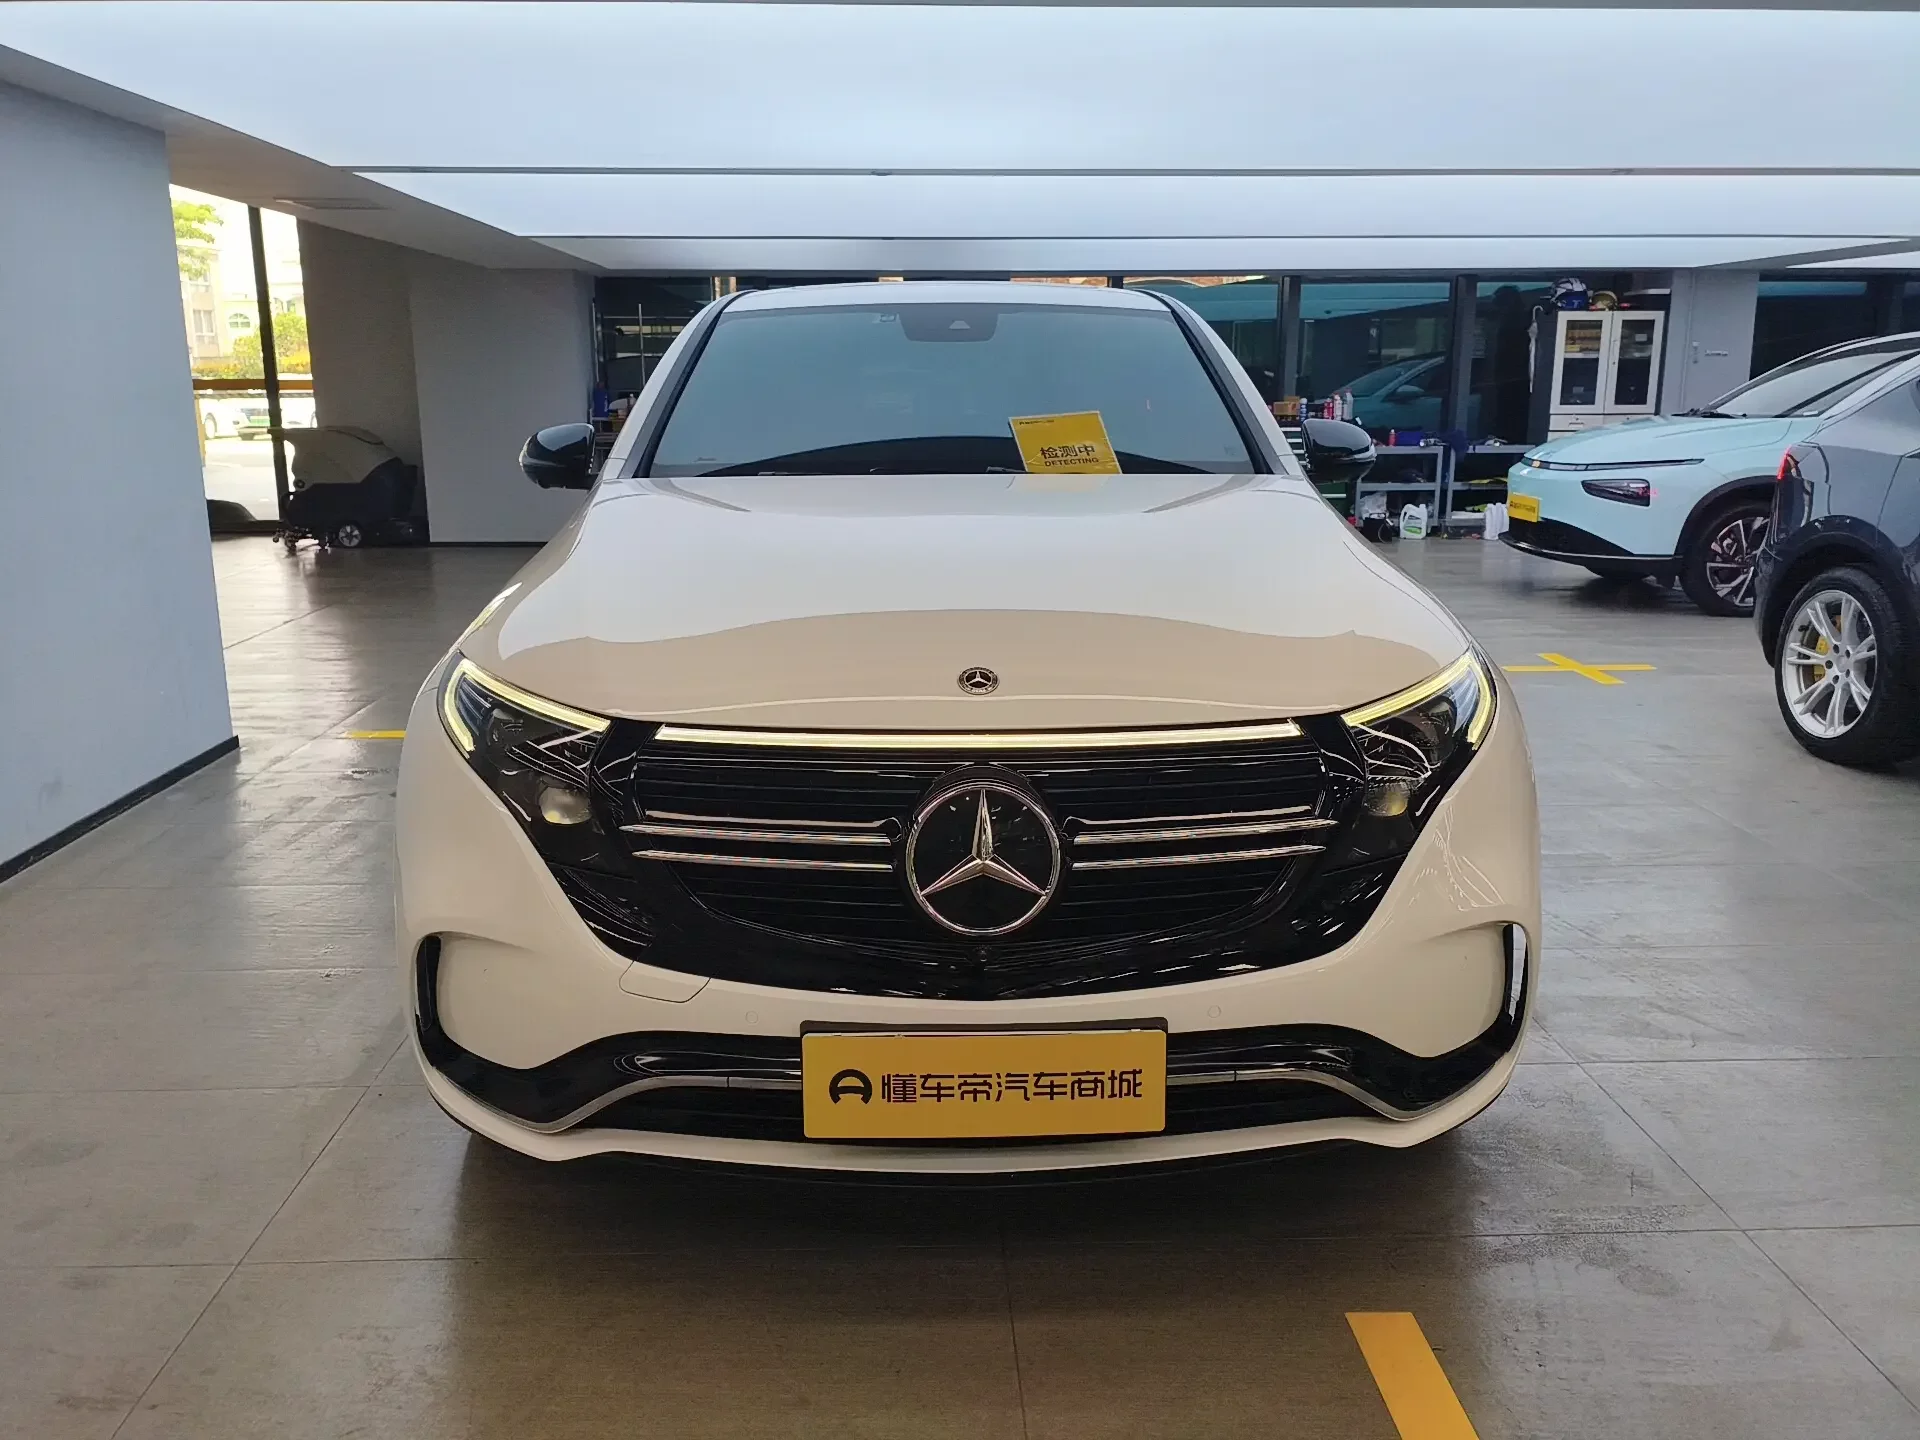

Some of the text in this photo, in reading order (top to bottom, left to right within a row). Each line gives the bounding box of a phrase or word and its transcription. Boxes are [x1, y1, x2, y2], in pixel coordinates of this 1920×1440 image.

[1040, 445, 1096, 459] 检测中
[1044, 457, 1099, 467] DETECTING
[881, 1069, 1143, 1103] 懂车帝汽车商城
